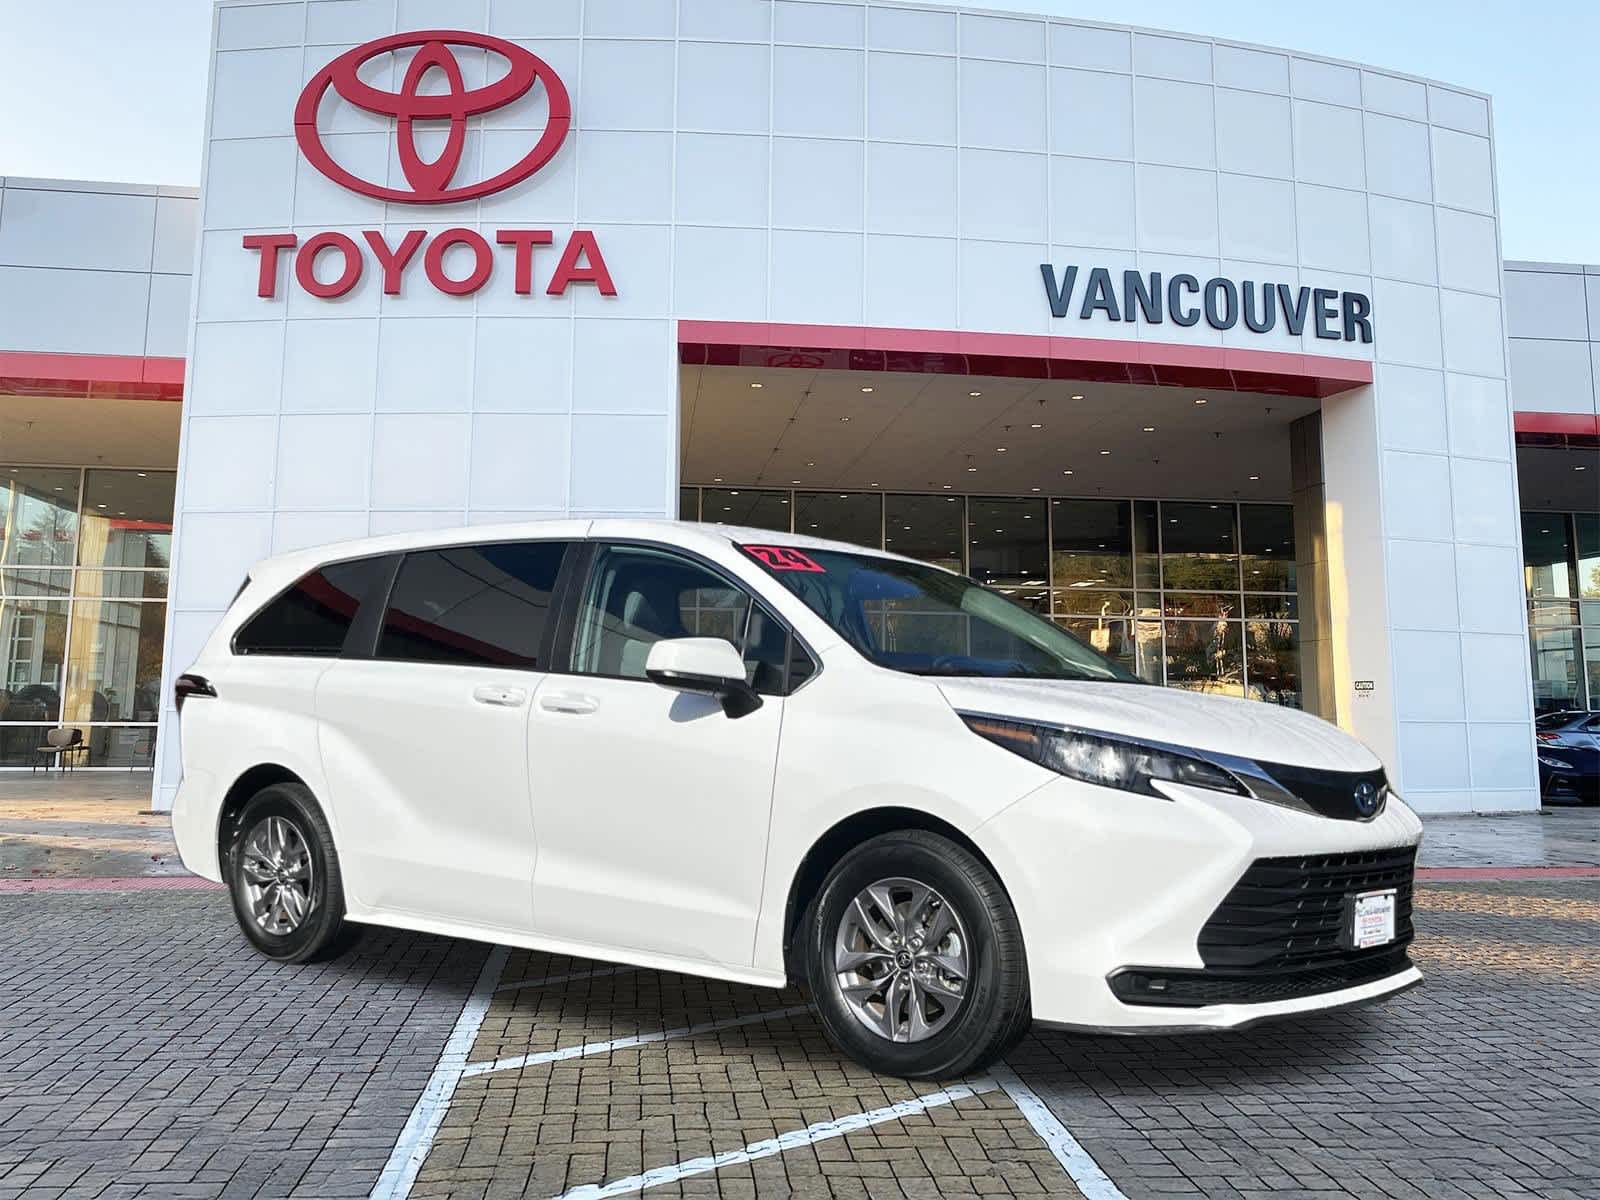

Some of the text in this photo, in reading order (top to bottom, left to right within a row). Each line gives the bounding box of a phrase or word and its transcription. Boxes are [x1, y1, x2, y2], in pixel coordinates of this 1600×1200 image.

[243, 227, 618, 299] TOYOTA
[1040, 264, 1373, 343] VANCOUVER
[750, 547, 813, 568] 24
